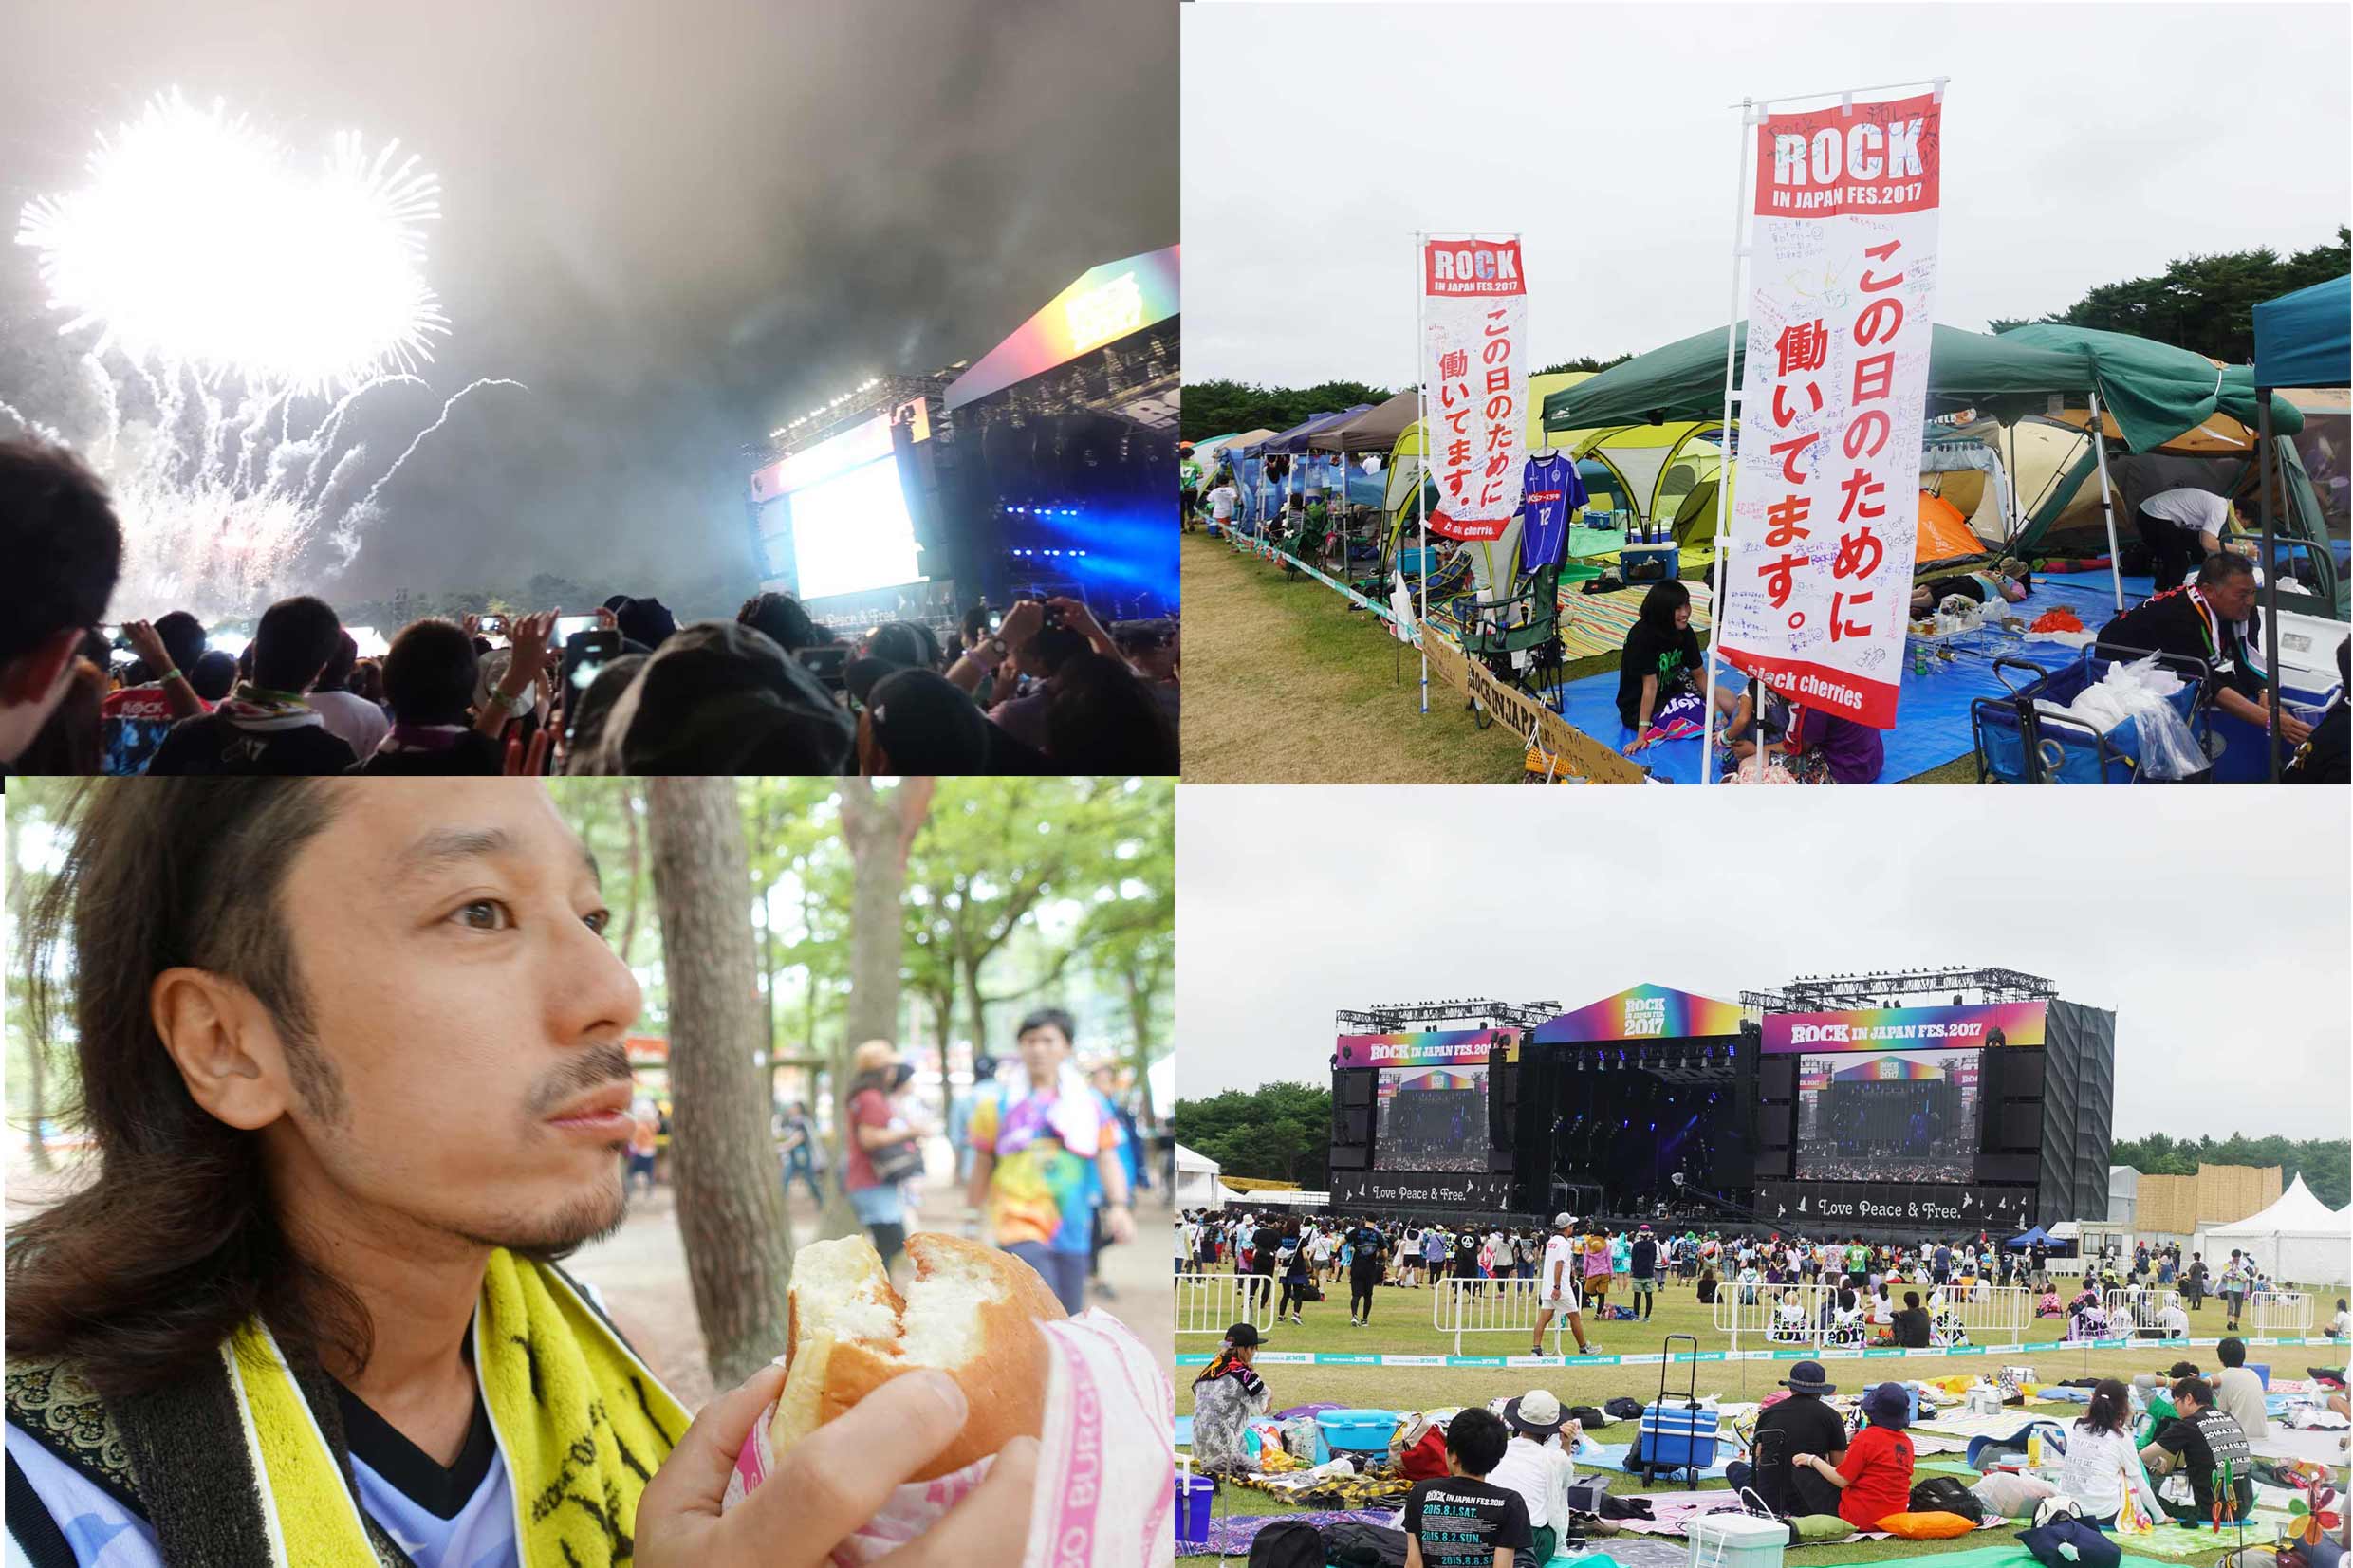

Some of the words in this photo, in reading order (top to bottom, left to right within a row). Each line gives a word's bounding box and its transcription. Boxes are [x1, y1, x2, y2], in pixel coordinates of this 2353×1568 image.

[1774, 118, 1925, 186] ROCK
[1772, 190, 1790, 208] IN
[1795, 188, 1843, 209] JAPAN
[1847, 182, 1922, 205] FES.2017
[1435, 249, 1518, 280] ROCK
[1435, 282, 1446, 291] IN
[1447, 282, 1475, 292] JAPAN
[1476, 281, 1518, 291] FES.2017
[1481, 308, 1513, 509] この日のために
[1439, 348, 1473, 507] 働いてます。
[1829, 239, 1904, 644] この日のために
[1758, 318, 1829, 630] 働いてます。
[1539, 507, 1552, 526] 12
[1799, 673, 1862, 710] cherries
[121, 701, 164, 715] ROCK
[1625, 998, 1665, 1013] ROCK
[1624, 1017, 1664, 1036] 2017
[1791, 1024, 1850, 1044] ROCK
[1852, 1028, 1868, 1041] IN
[1869, 1026, 1917, 1040] JAPAN
[1918, 1023, 1983, 1038] FES.2017
[1370, 1044, 1410, 1061] ROCK
[1411, 1046, 1422, 1058] IN
[1423, 1044, 1454, 1057] JAPAN
[1372, 1185, 1396, 1200] Love
[1399, 1186, 1428, 1200] Peace
[1430, 1188, 1438, 1201] &
[1440, 1188, 1466, 1202] Free.
[1818, 1199, 1853, 1216] Love
[1859, 1200, 1902, 1218] Peace
[1907, 1201, 1919, 1217] &
[1921, 1202, 1962, 1221] Free.
[1828, 1323, 1865, 1344] 2017
[1425, 1489, 1447, 1503] ROCK
[1446, 1493, 1454, 1502] IN
[1454, 1494, 1476, 1504] JAPAN
[1423, 1504, 1477, 1518] 2015.8.1.SAT.
[1421, 1530, 1483, 1543] 2015.8.2.SUN.
